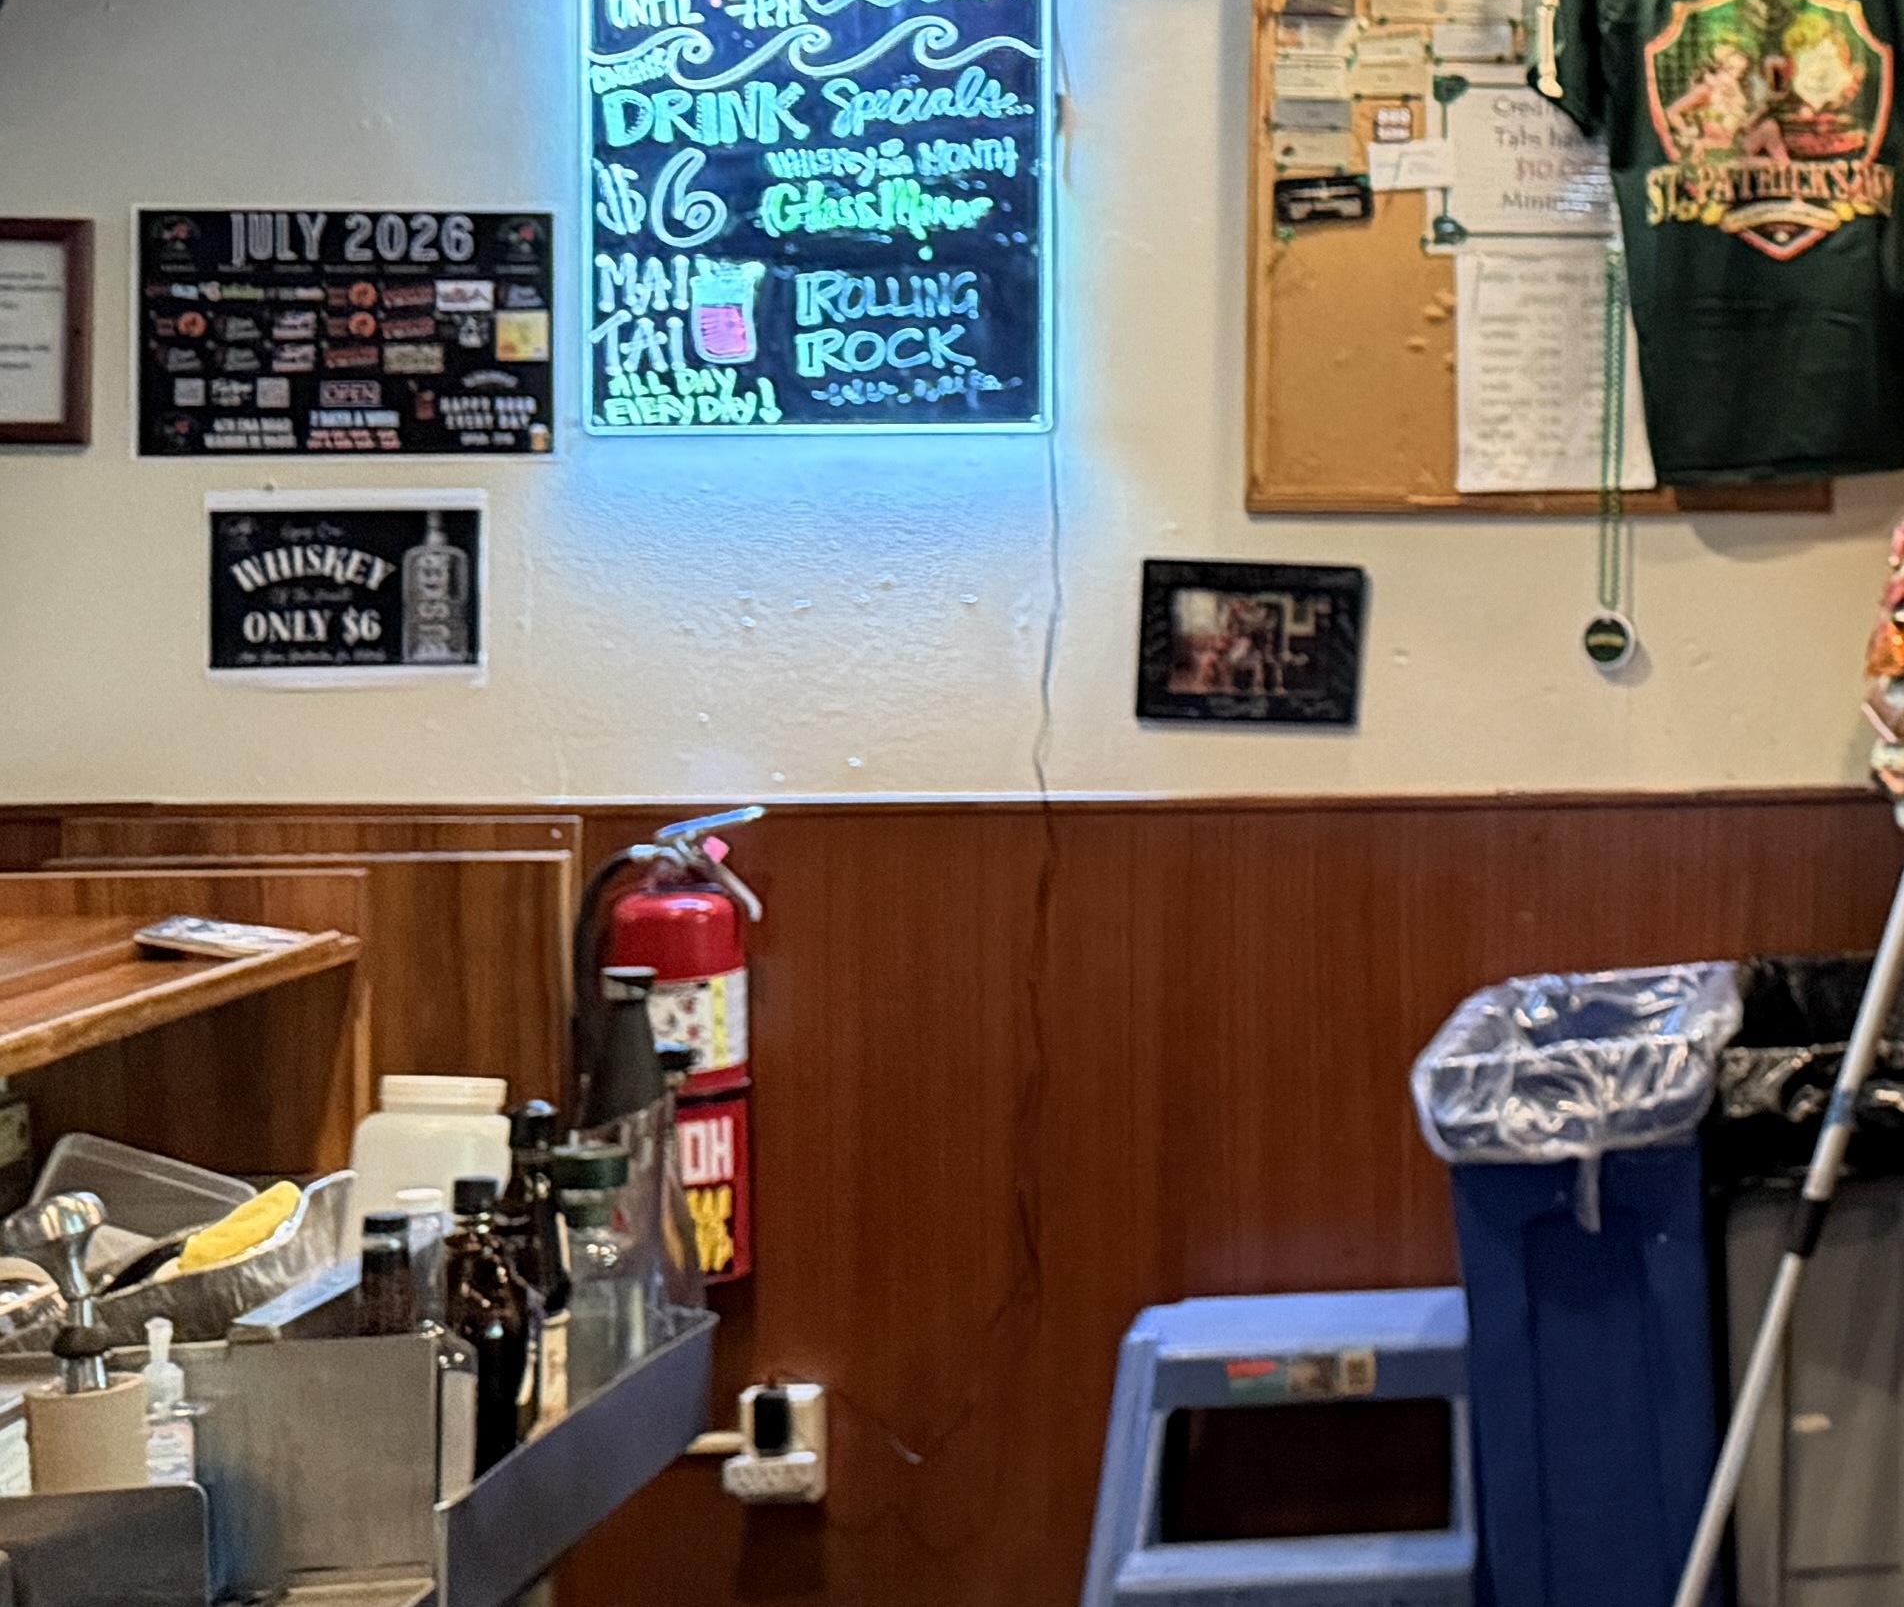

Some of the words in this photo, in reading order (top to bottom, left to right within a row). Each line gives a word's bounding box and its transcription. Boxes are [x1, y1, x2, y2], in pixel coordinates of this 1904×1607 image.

[602, 80, 811, 147] DRINK
[917, 135, 1020, 179] MONTH
[593, 147, 728, 248] $6
[230, 212, 328, 268] JULY
[343, 213, 475, 263] 2026
[594, 252, 691, 316] MAI
[795, 269, 979, 326] ROLLING
[588, 309, 688, 376] TAI
[795, 324, 977, 378] ROCK
[230, 543, 398, 593] WHISKEY
[243, 609, 332, 644] ONLY
[341, 605, 383, 646] $6
